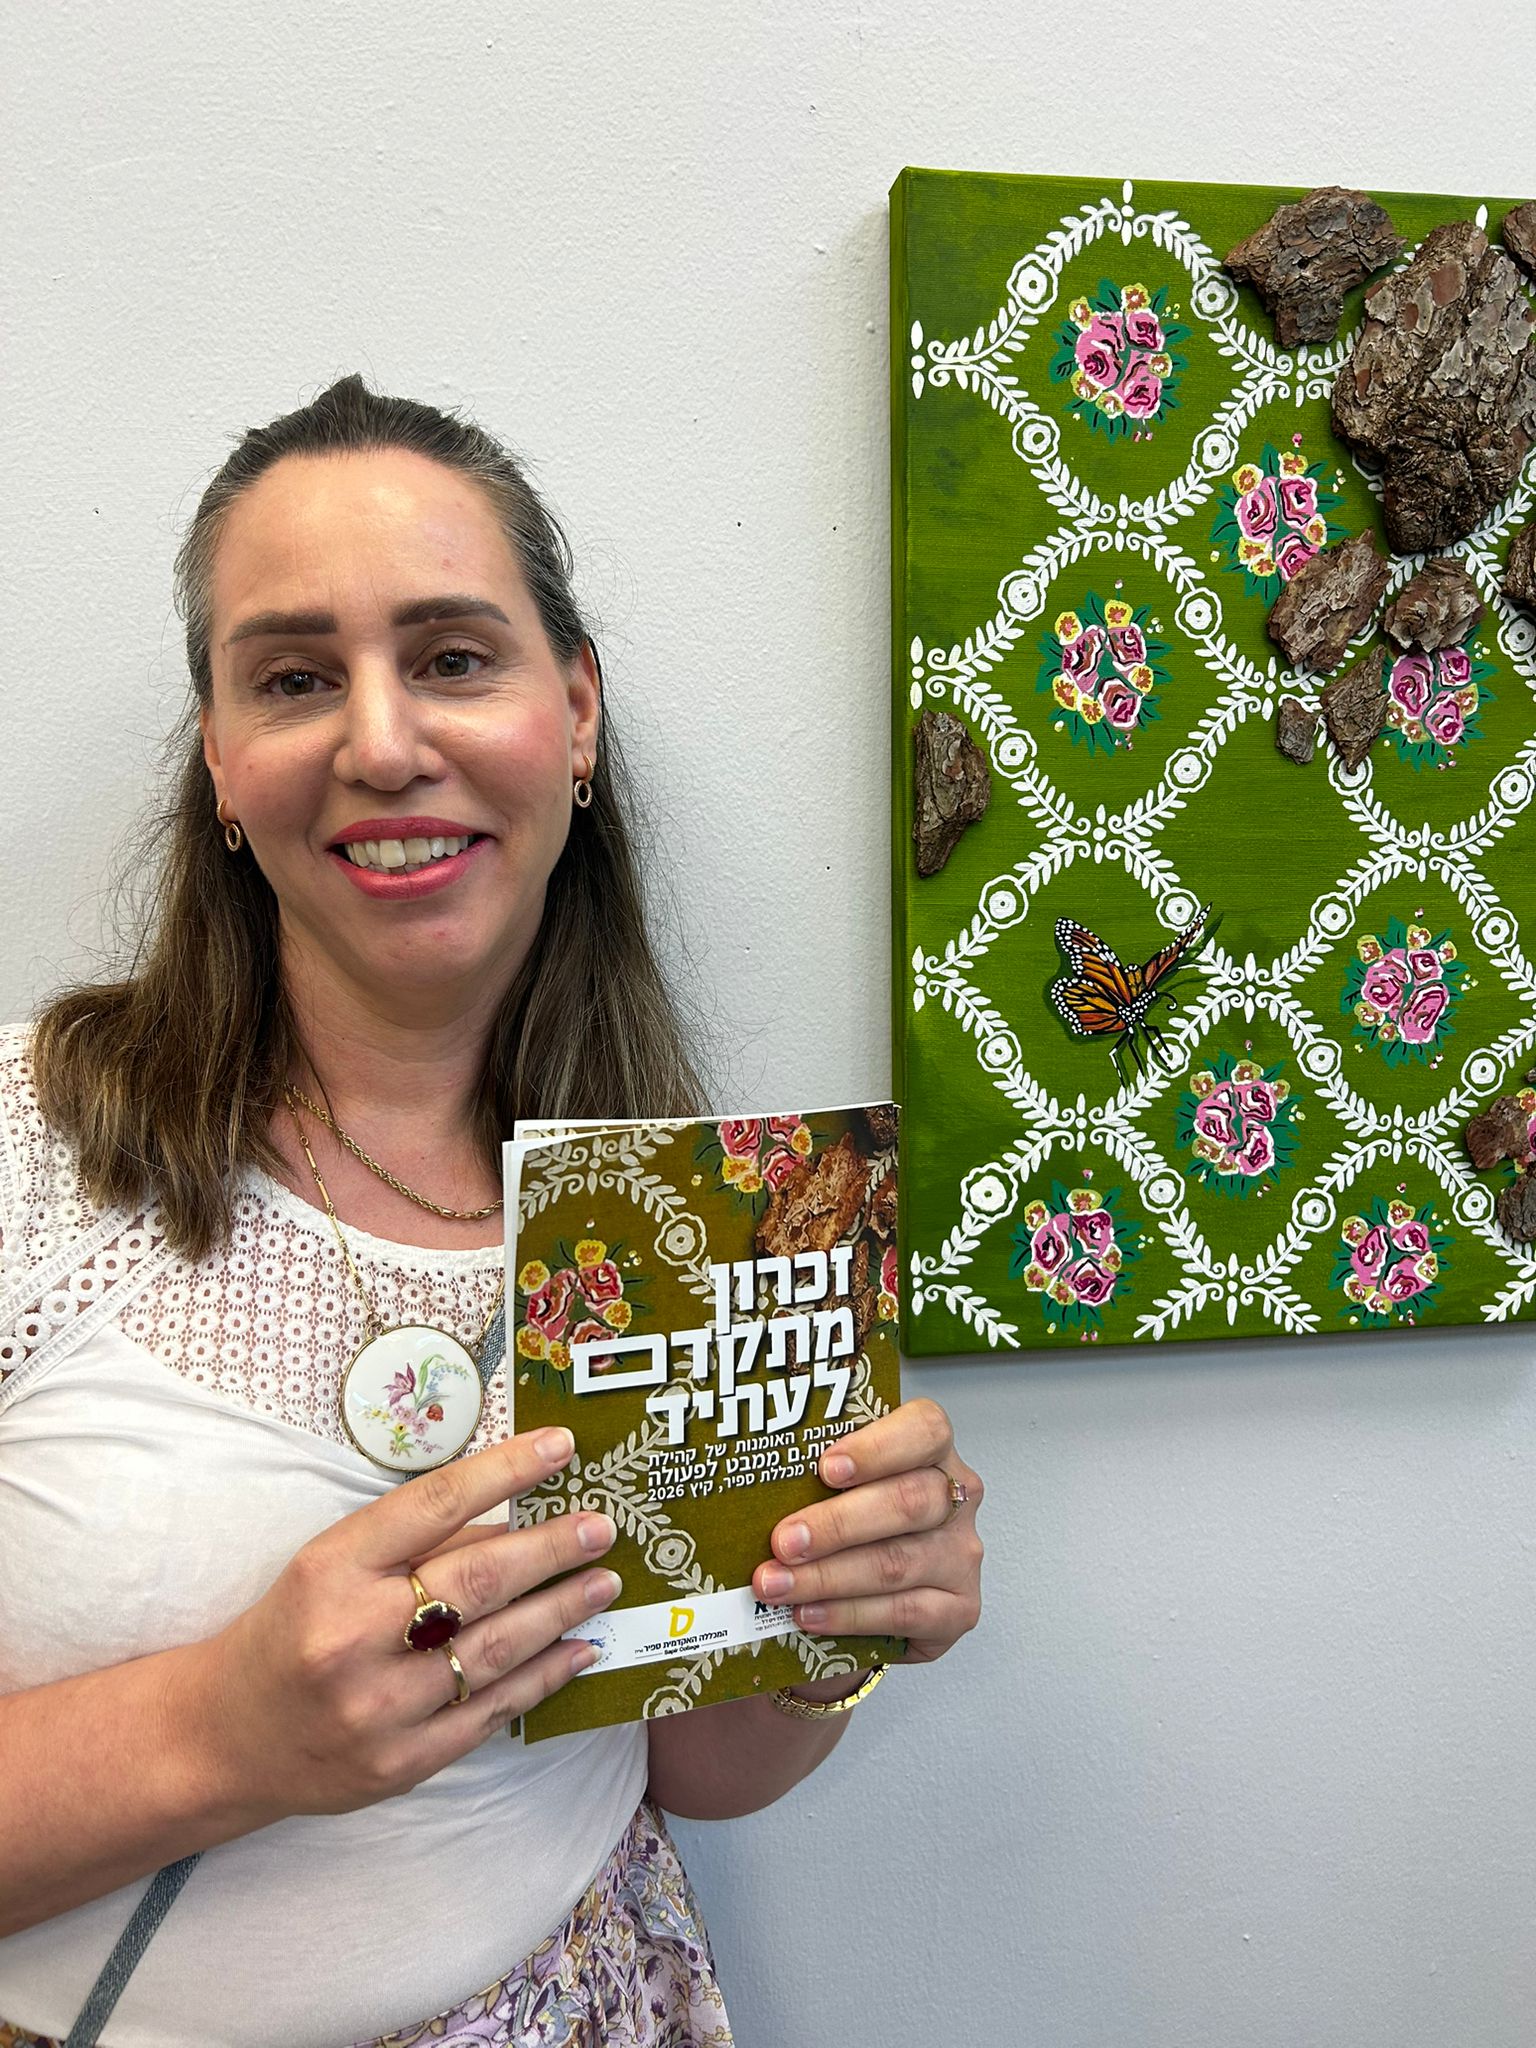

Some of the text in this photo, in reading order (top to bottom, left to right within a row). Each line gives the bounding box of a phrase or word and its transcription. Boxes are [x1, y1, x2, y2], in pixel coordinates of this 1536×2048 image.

[709, 1246, 853, 1335] זכרון
[569, 1309, 855, 1396] מתקדם
[646, 1360, 851, 1445] לעתיד
[647, 1420, 855, 1469] תערוכת האומנות של קהילת
[647, 1459, 718, 1487] לפעולה
[725, 1452, 780, 1474] ממבט
[760, 1464, 805, 1483] מכללת
[647, 1484, 685, 1502] 2026
[690, 1480, 714, 1499] קיץ
[662, 1635, 698, 1649] האקדמית
[699, 1629, 728, 1642] המכללה
[643, 1642, 661, 1652] ספיר
